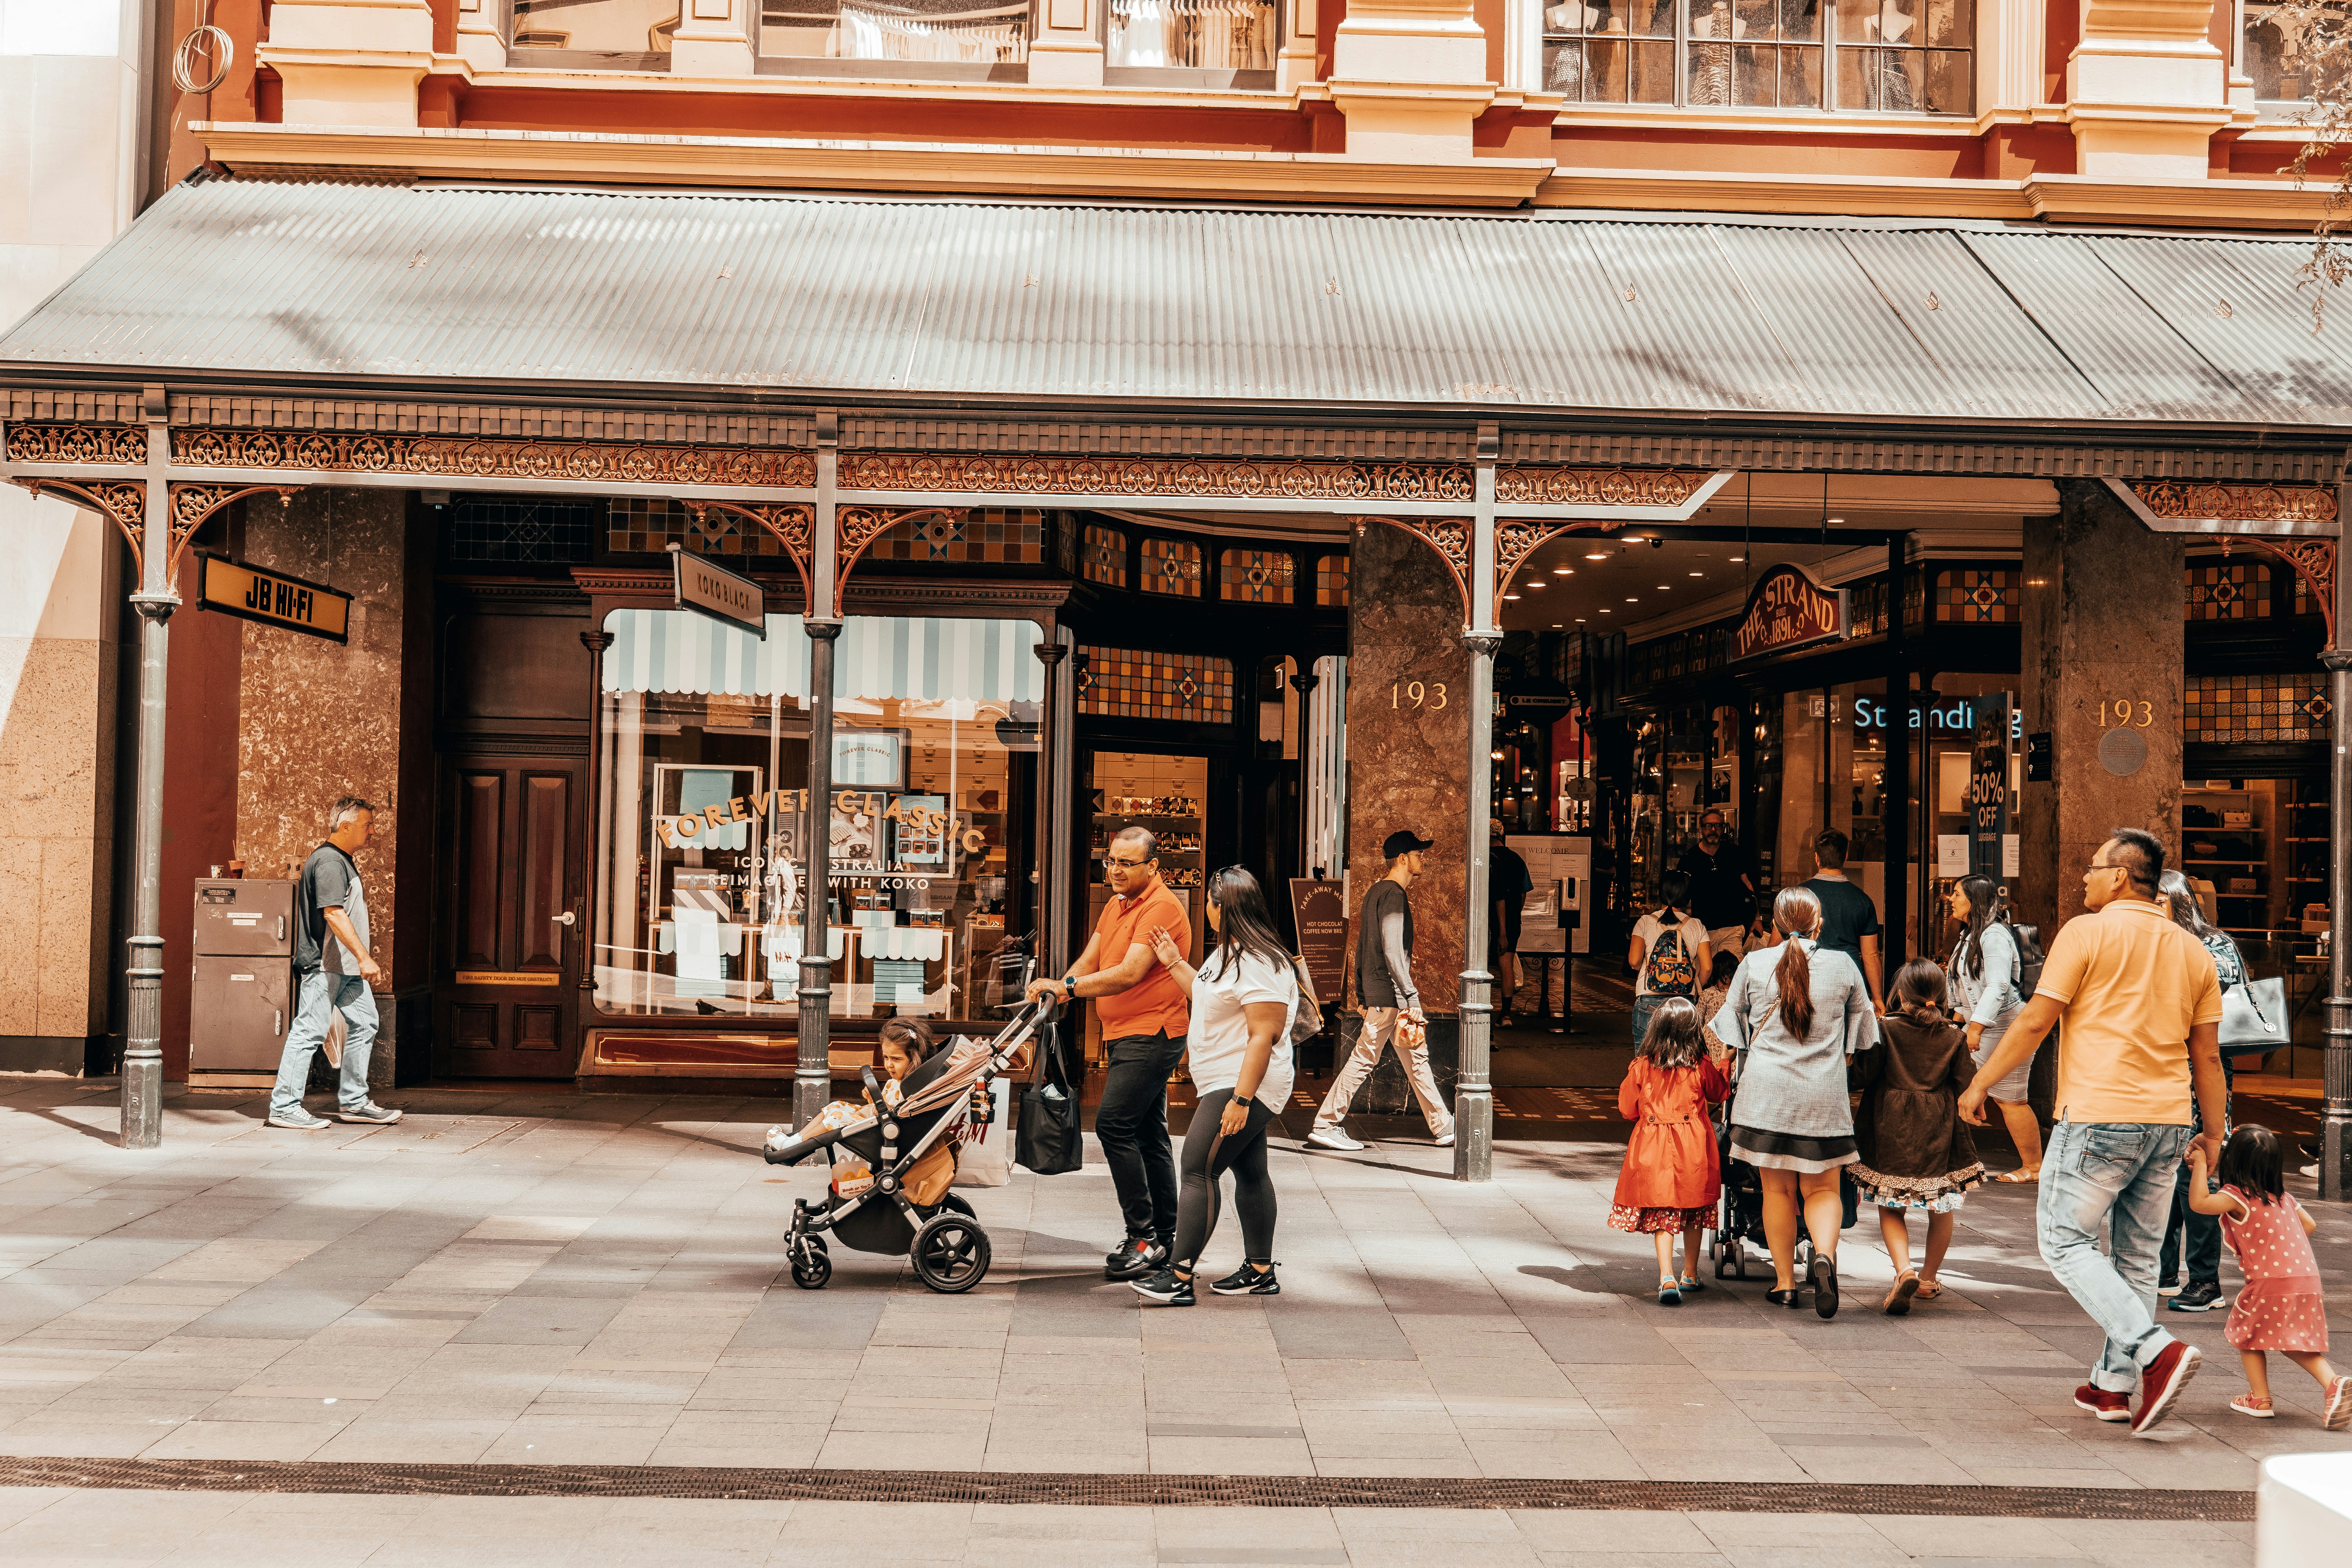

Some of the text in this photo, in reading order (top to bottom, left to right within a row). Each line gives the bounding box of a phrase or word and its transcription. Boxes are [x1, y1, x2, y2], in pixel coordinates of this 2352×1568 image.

[246, 575, 313, 623] JB HI-FI
[697, 572, 750, 611] KOKO BLACK
[1737, 574, 1833, 656] THE STRAND
[1776, 606, 1786, 617] BUILT
[1772, 616, 1791, 643] 1891
[1390, 681, 1447, 710] 193
[2098, 699, 2153, 727] 193
[839, 746, 891, 757] FOREVER CLASSIC
[1972, 771, 2004, 804] 50%
[836, 789, 985, 853] CLASSIC
[1978, 806, 1997, 827] OFF
[1978, 832, 1996, 841] LUGGAGE
[828, 877, 871, 888] WITH
[880, 878, 929, 890] KOKO
[1300, 886, 1332, 910] TAKE-AWAY
[1474, 1129, 1480, 1139] R
